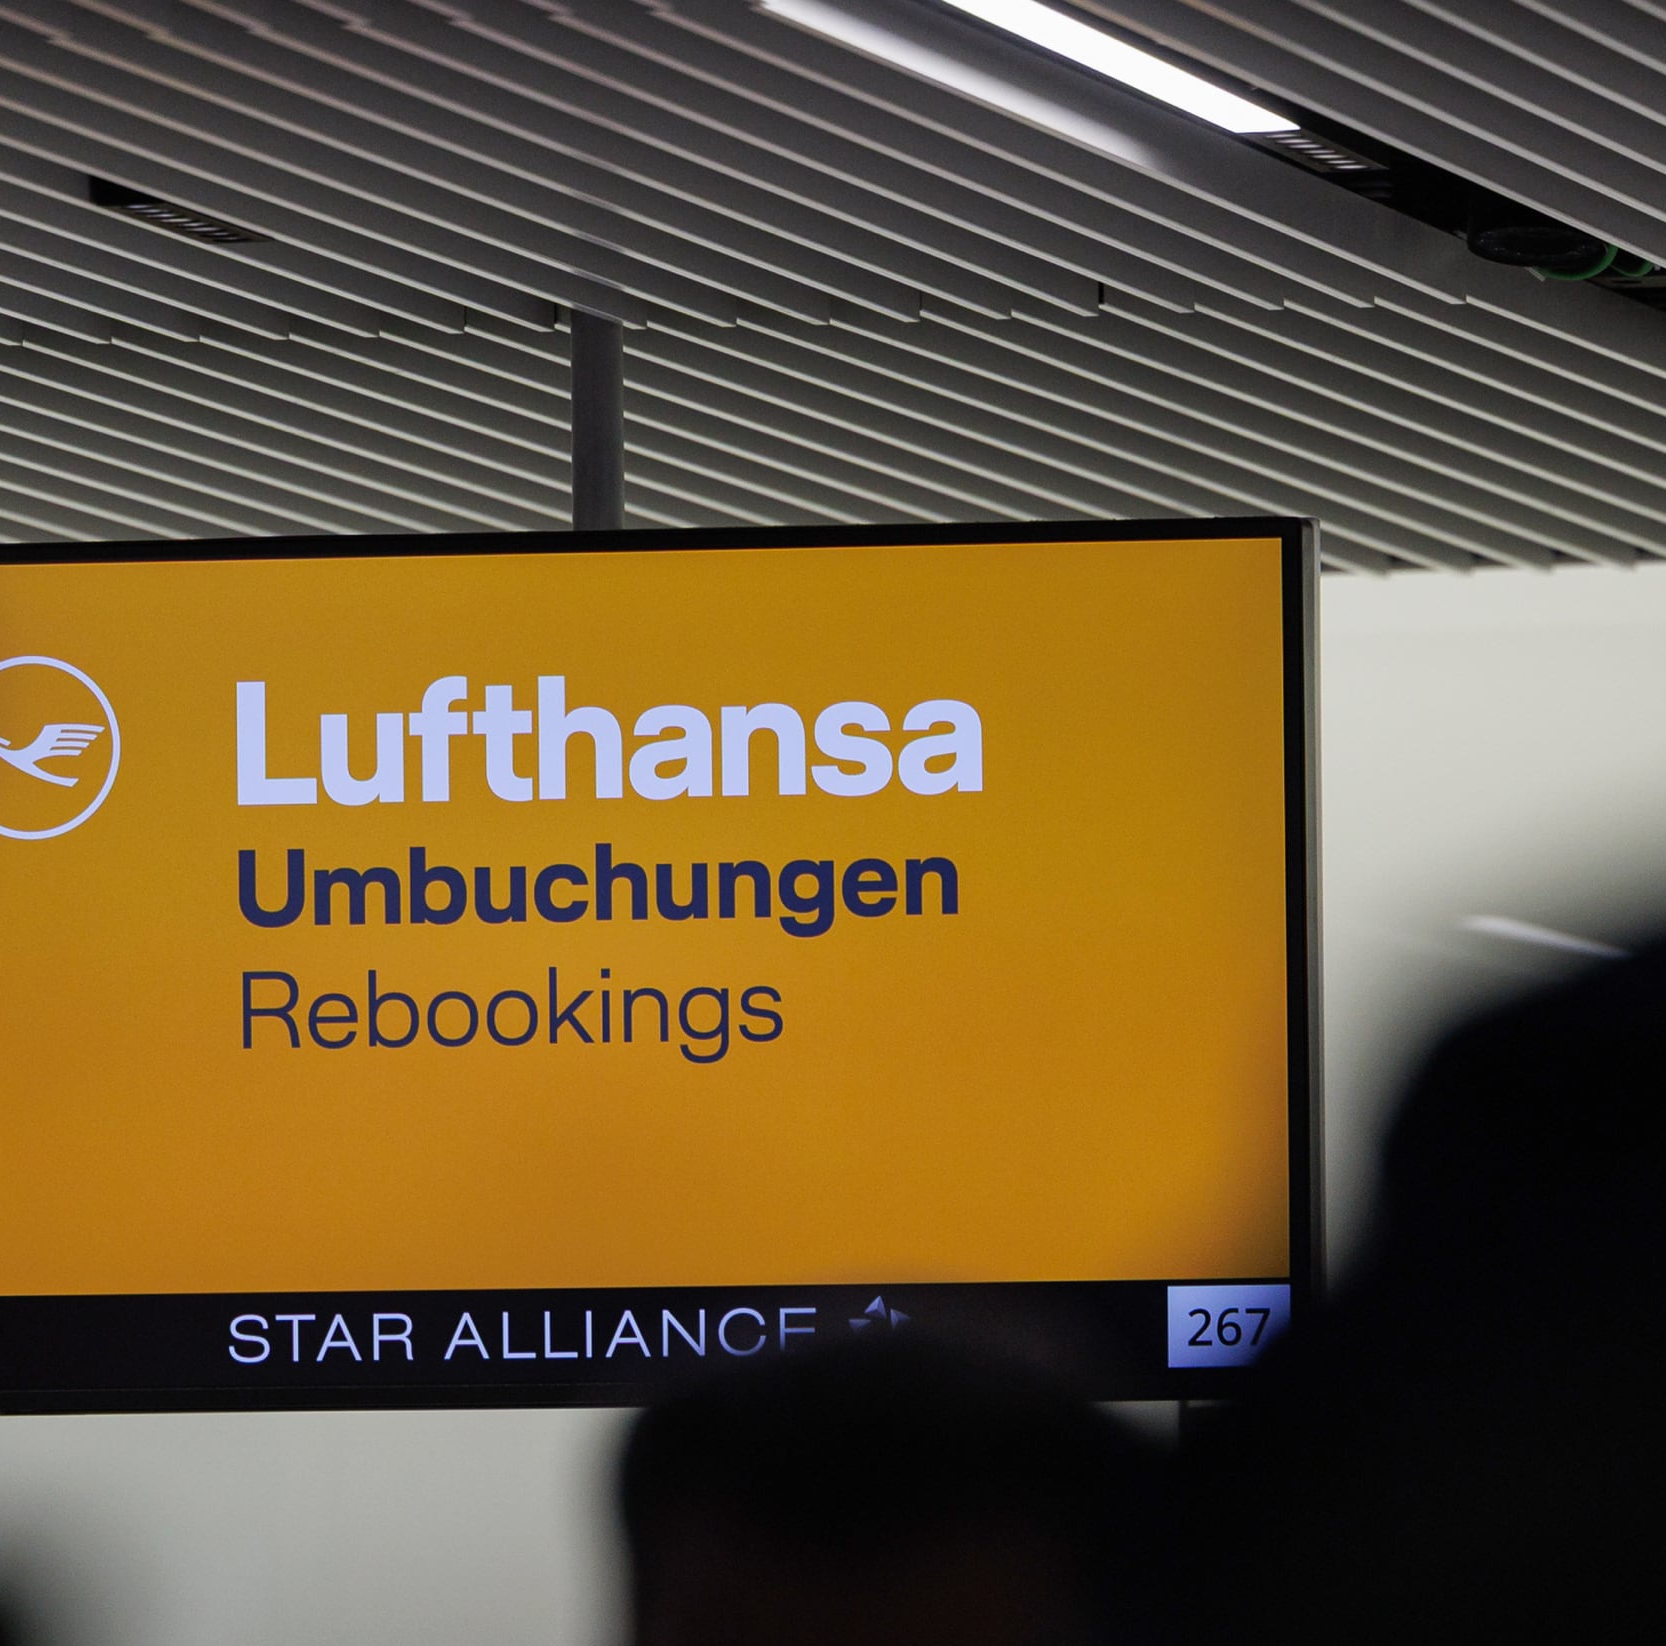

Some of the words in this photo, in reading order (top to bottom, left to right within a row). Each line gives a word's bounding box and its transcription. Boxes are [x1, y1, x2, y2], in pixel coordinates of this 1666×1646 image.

[235, 675, 984, 806] Lufthansa
[237, 842, 960, 938] Umbuchungen
[241, 965, 785, 1064] Rebookings
[227, 1312, 415, 1365] STAR
[1187, 1307, 1271, 1347] 267
